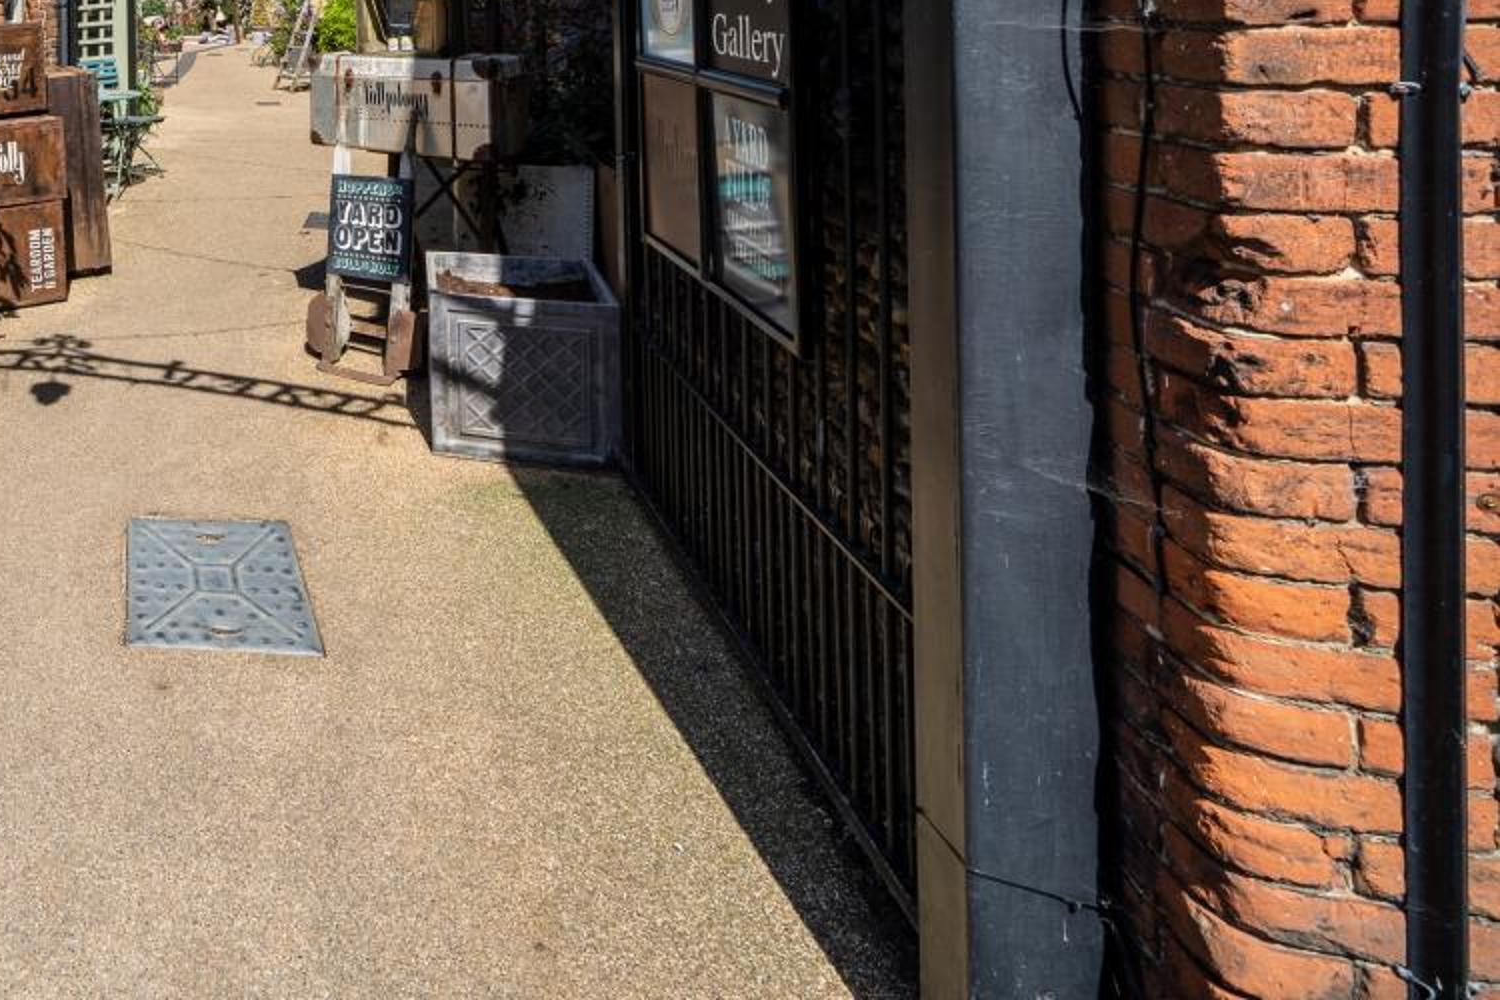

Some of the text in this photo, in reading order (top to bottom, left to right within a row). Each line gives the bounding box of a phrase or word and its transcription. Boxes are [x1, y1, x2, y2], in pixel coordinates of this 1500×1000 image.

[711, 11, 786, 79] Gallery
[335, 199, 403, 229] YARD
[28, 229, 43, 293] TEAROOM
[333, 224, 403, 255] OPEN
